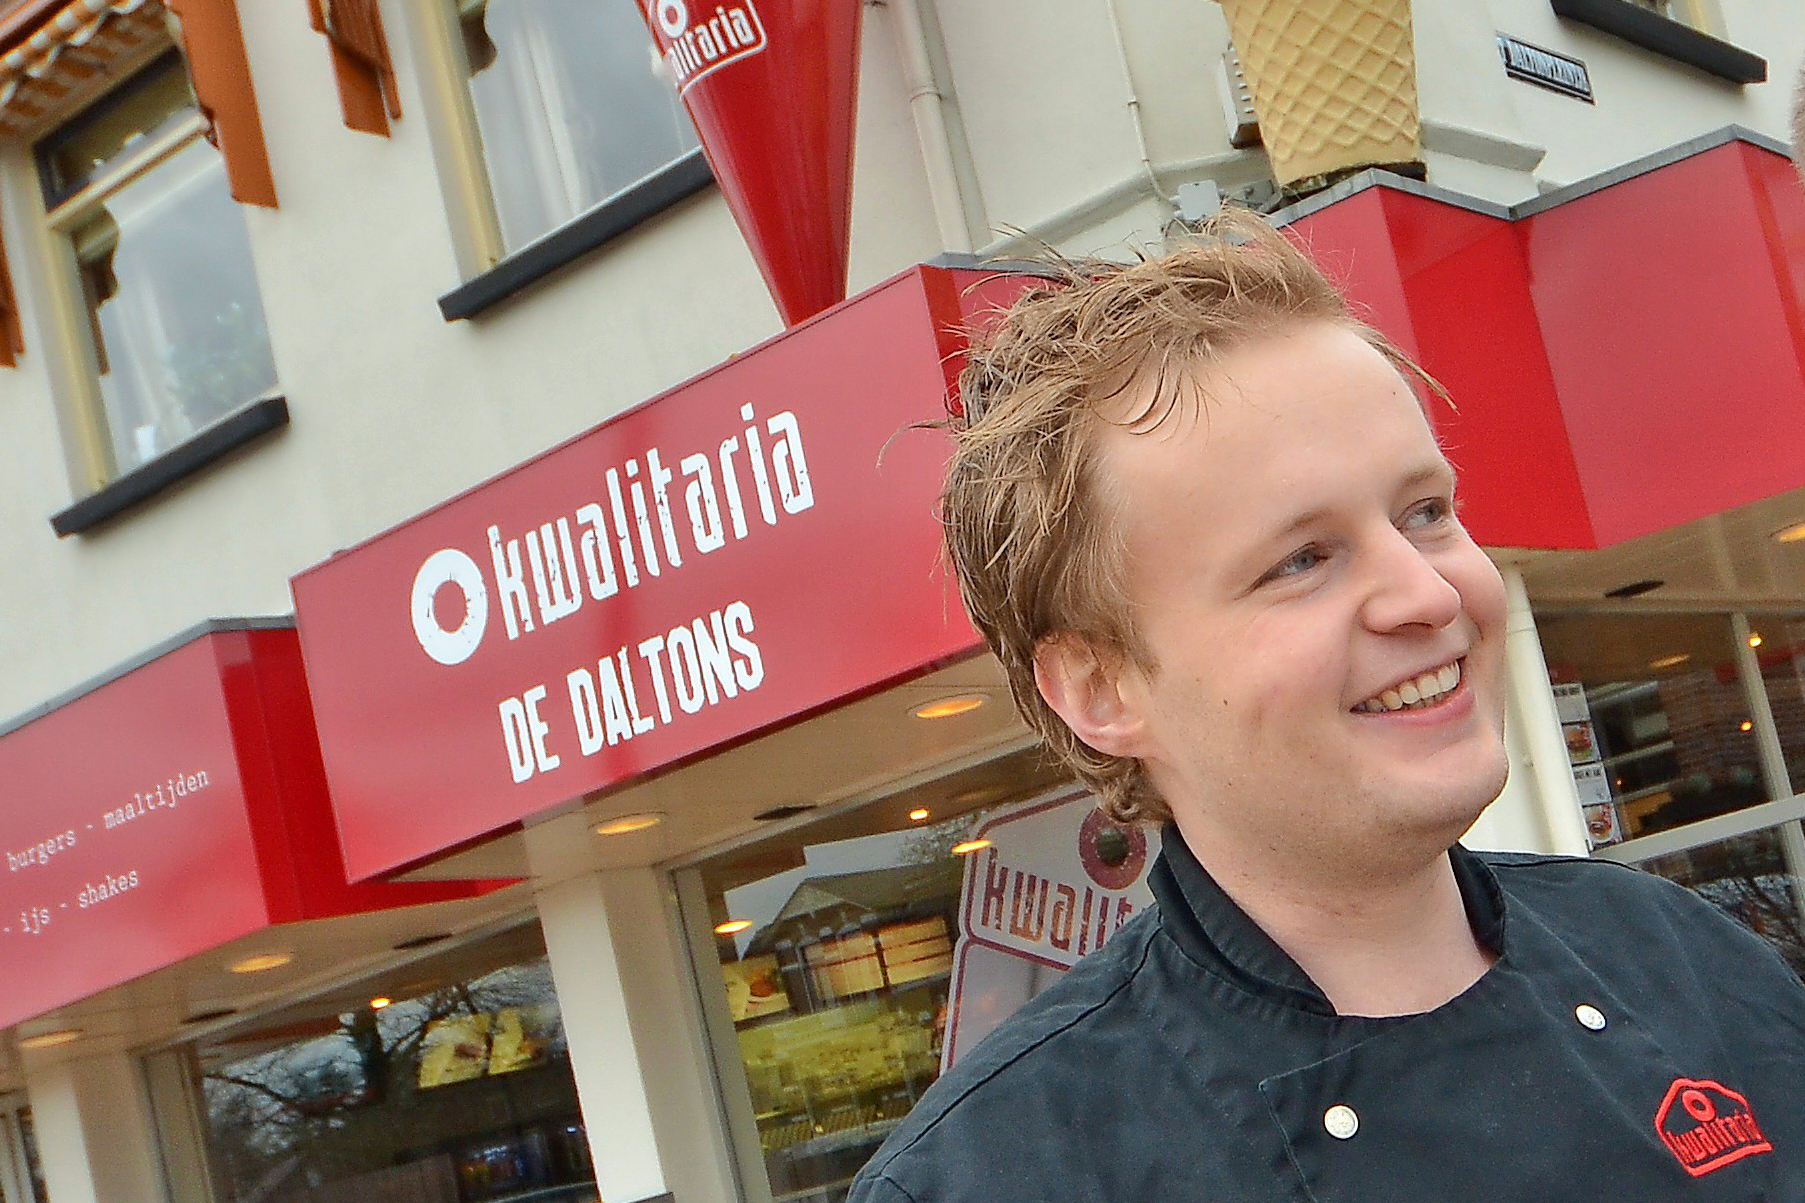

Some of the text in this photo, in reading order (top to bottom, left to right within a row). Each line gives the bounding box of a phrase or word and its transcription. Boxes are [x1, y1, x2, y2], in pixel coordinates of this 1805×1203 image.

[487, 401, 815, 641] kwalitaria
[498, 600, 765, 784] DE DALTONS
[6, 829, 77, 872] burgers
[103, 769, 211, 829] maaltijden
[20, 906, 51, 935] ijs
[78, 869, 140, 909] shakes
